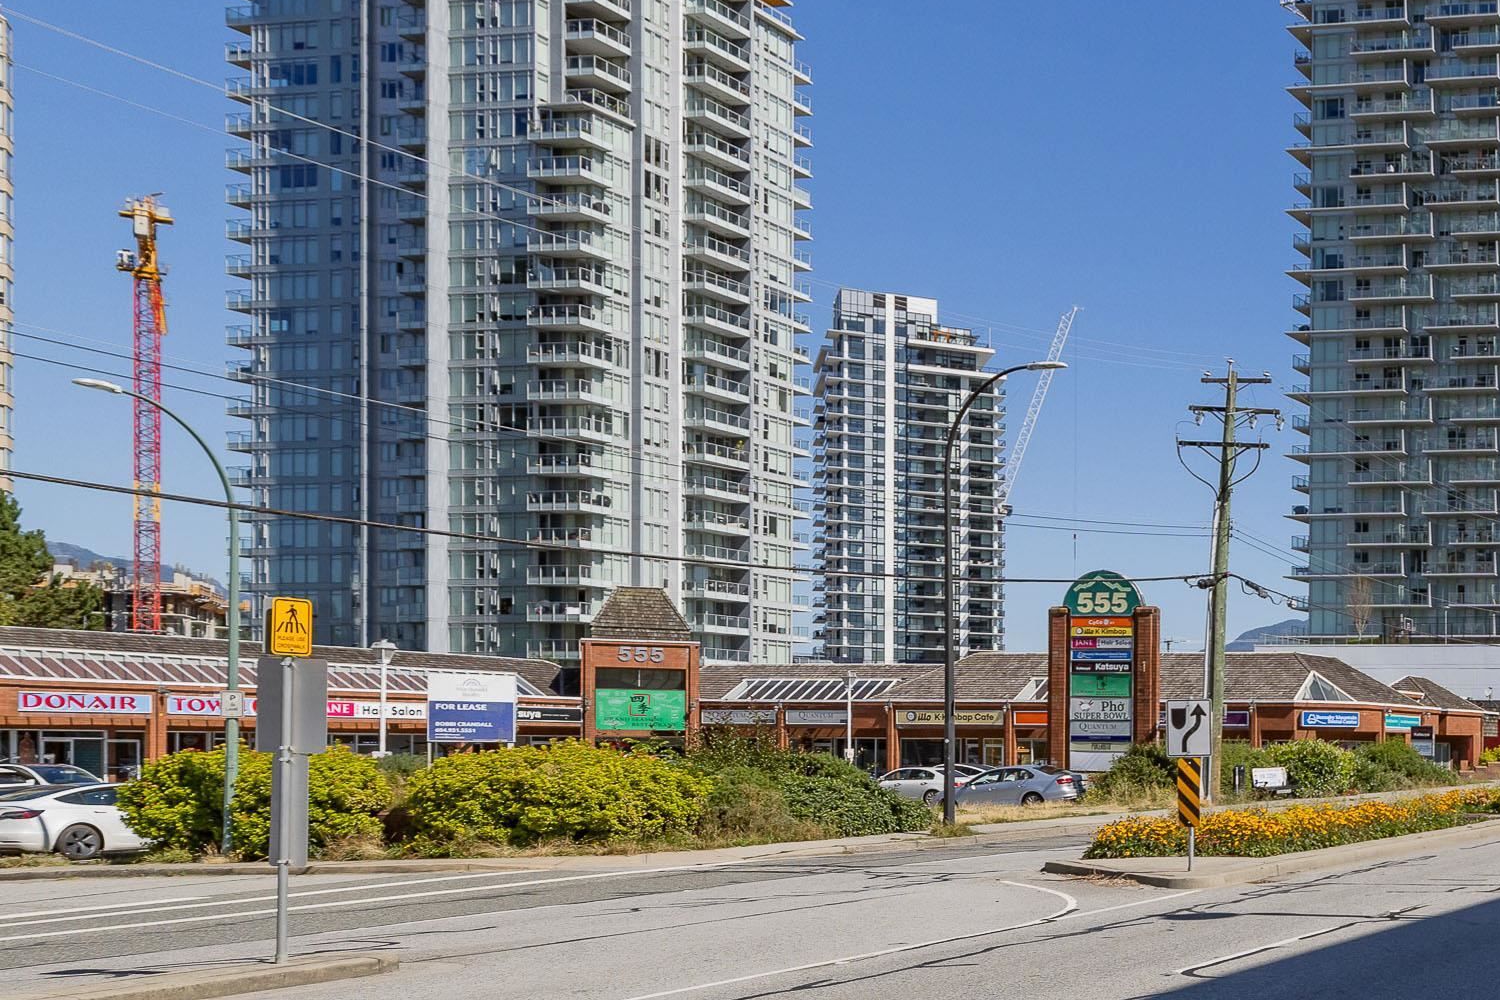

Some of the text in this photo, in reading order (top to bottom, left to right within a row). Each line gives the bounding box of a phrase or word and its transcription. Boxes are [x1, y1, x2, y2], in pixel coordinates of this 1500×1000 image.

[1076, 592, 1128, 613] 555
[617, 646, 665, 663] 555
[1095, 663, 1129, 672] Katsuya
[22, 693, 137, 710] DONAIR
[173, 697, 220, 712] TOW
[391, 706, 423, 716] Salon
[456, 703, 488, 711] LEASE
[517, 710, 542, 719] suya
[798, 711, 834, 720] QUANTUM
[974, 713, 995, 721] Cafe
[1073, 712, 1129, 720] SUPER BOWL
[1079, 721, 1117, 732] QUANTUM
